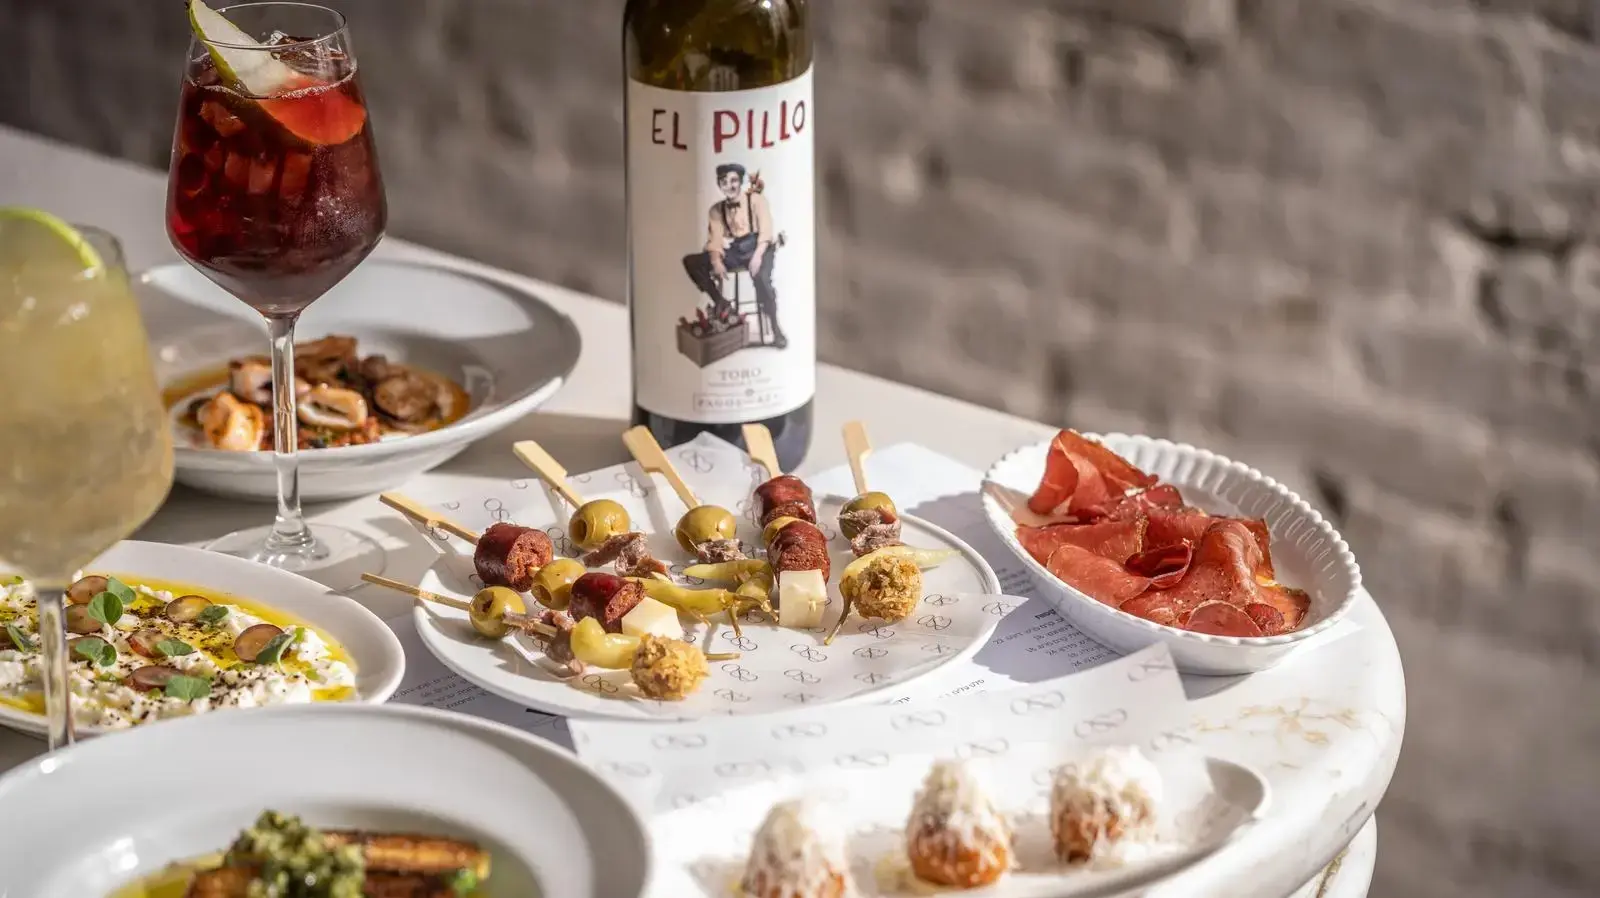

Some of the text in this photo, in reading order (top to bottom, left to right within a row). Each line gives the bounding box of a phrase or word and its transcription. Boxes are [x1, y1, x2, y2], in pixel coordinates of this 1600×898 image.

[652, 100, 805, 154] EL PILLO
[719, 368, 762, 381] TORO
